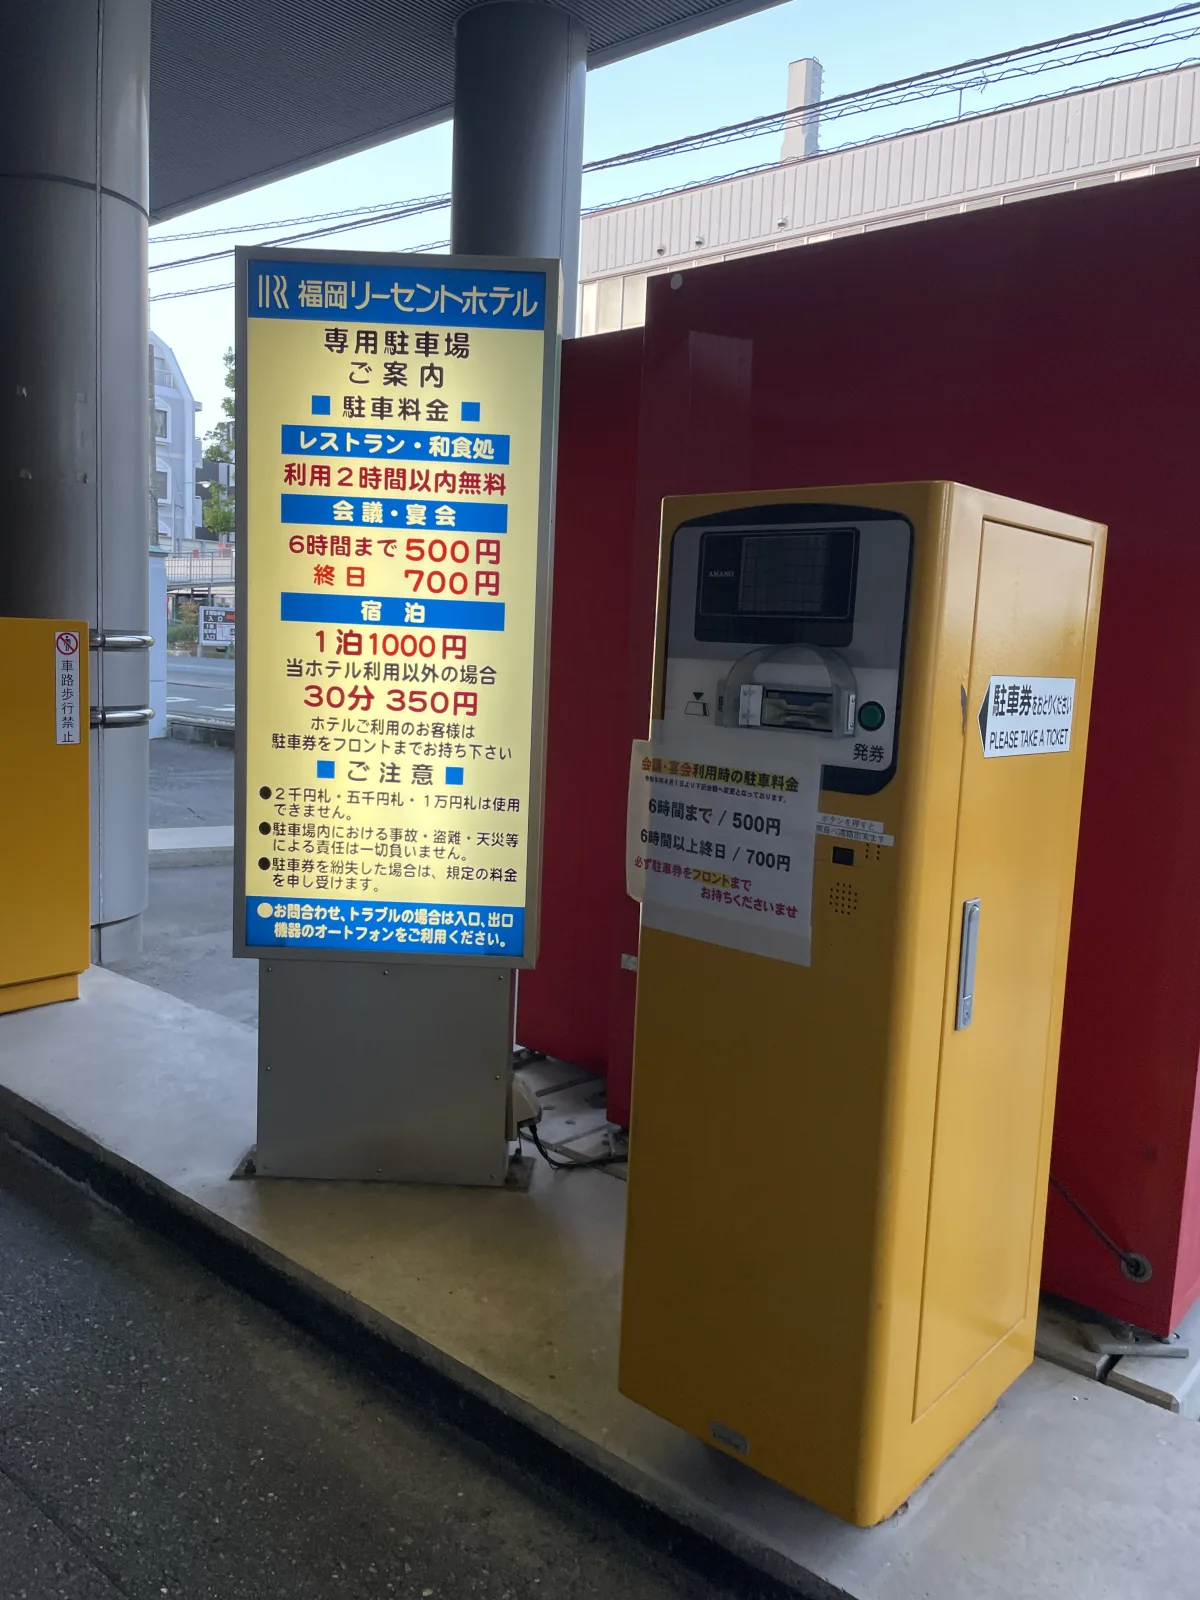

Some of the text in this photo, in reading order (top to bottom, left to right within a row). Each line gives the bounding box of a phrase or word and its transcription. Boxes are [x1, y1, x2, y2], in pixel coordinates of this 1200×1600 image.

[298, 279, 538, 317] 福岡リーセントホテル
[324, 327, 470, 359] 専用駐車場
[349, 361, 444, 389] ご案内
[342, 395, 449, 422] 駐車料金
[299, 430, 495, 460] レストラン・和食処
[283, 462, 507, 496] 利用2時間以内無料
[333, 500, 456, 527] 会議・宴会
[405, 538, 500, 565] 500円
[313, 564, 500, 597] 終日 700円
[361, 600, 425, 624] 宿泊
[286, 657, 498, 686] 当ホテル利用以外の場合
[61, 659, 75, 743] 車路歩行禁止
[304, 684, 479, 717] 30分 350円
[310, 715, 476, 740] ホテルご利用のお客様は
[990, 728, 1069, 750] PLEASE TAKE A TICKET
[271, 732, 513, 761] 駐車券をフロントまでお持ち下さい
[853, 743, 885, 763] 発券
[347, 760, 434, 786] ご注意
[641, 756, 800, 793] 会議・宴会利用時の駐車料金
[274, 803, 352, 821] できません。
[648, 797, 713, 825] 6時間まで
[732, 811, 781, 837] 500円
[272, 821, 520, 848] 駐車場内における事故・盗難・天災等
[273, 838, 468, 862] による責任は一切負いません。
[640, 828, 726, 860] 6時間以上終日
[746, 848, 791, 873] 700円
[271, 857, 518, 883] 駐車券を紛失した場合は、規定の料金
[272, 872, 380, 893] を申し受けます。
[634, 855, 752, 891] 必ず駐車券をフロントまで
[273, 902, 514, 928] お問合わせ、トラブルの場合は入口、出口
[700, 885, 798, 919] お持ちくださいませ
[274, 922, 506, 948] 機器のオートフォンをご利用ください。
